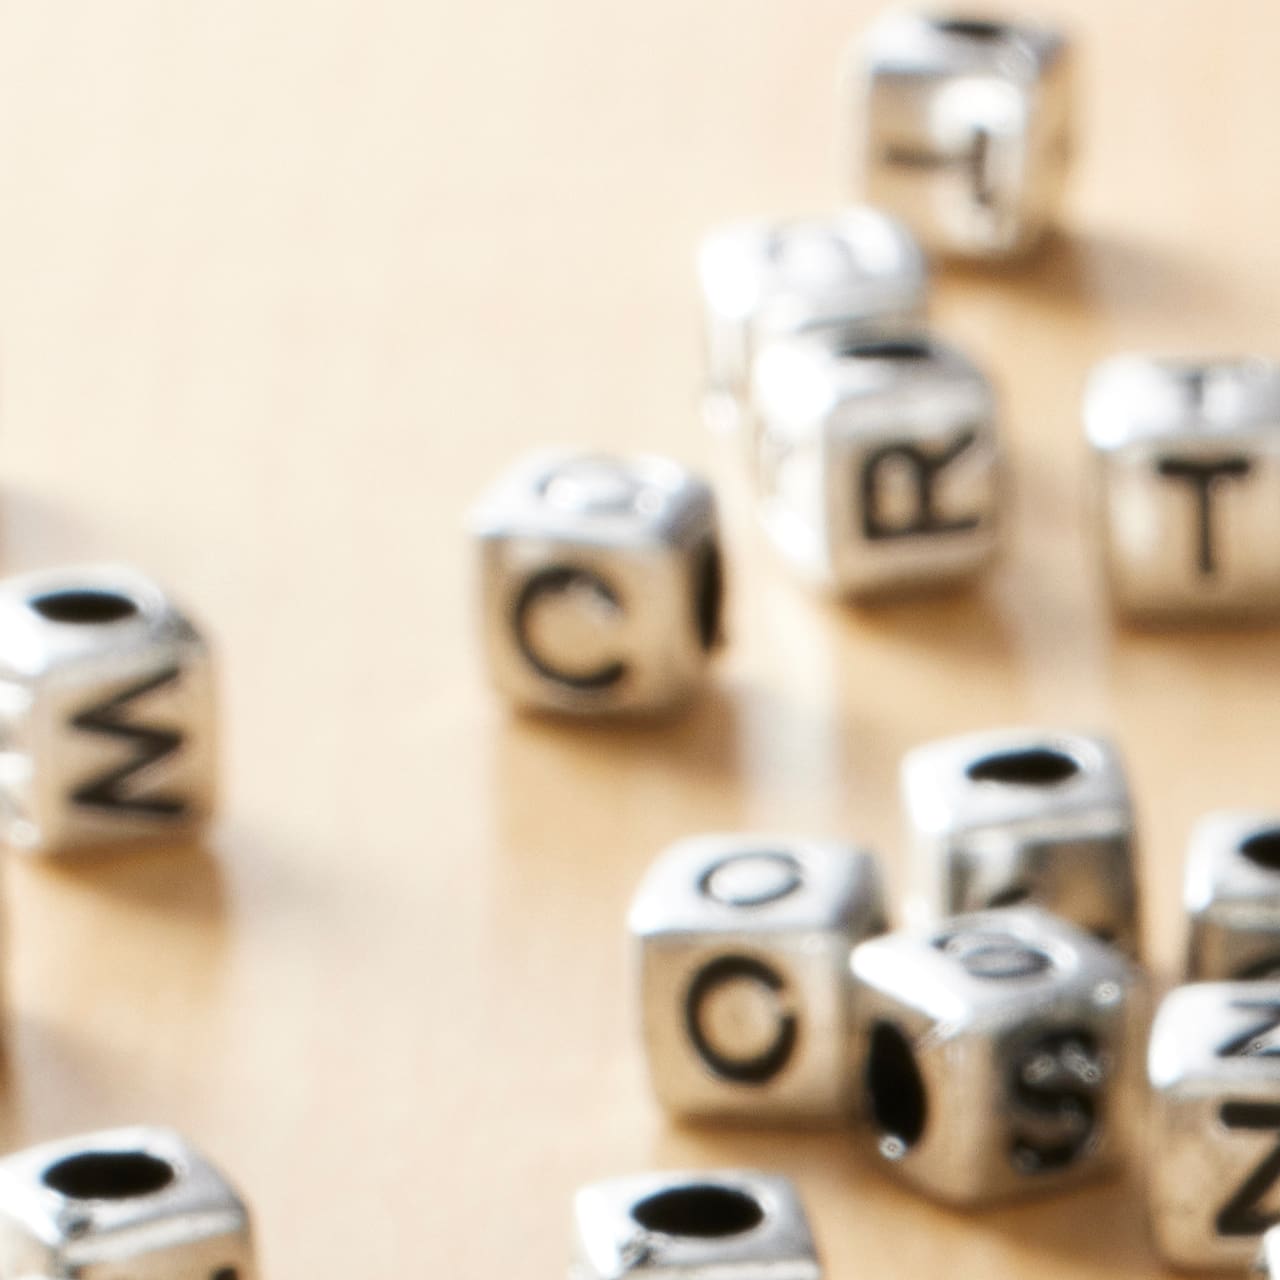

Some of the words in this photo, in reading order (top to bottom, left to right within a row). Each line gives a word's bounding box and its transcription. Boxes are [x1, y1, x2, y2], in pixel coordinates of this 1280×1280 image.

[858, 428, 982, 540] R
[1153, 458, 1252, 576] T
[510, 564, 629, 692] C
[684, 951, 798, 1087] O
